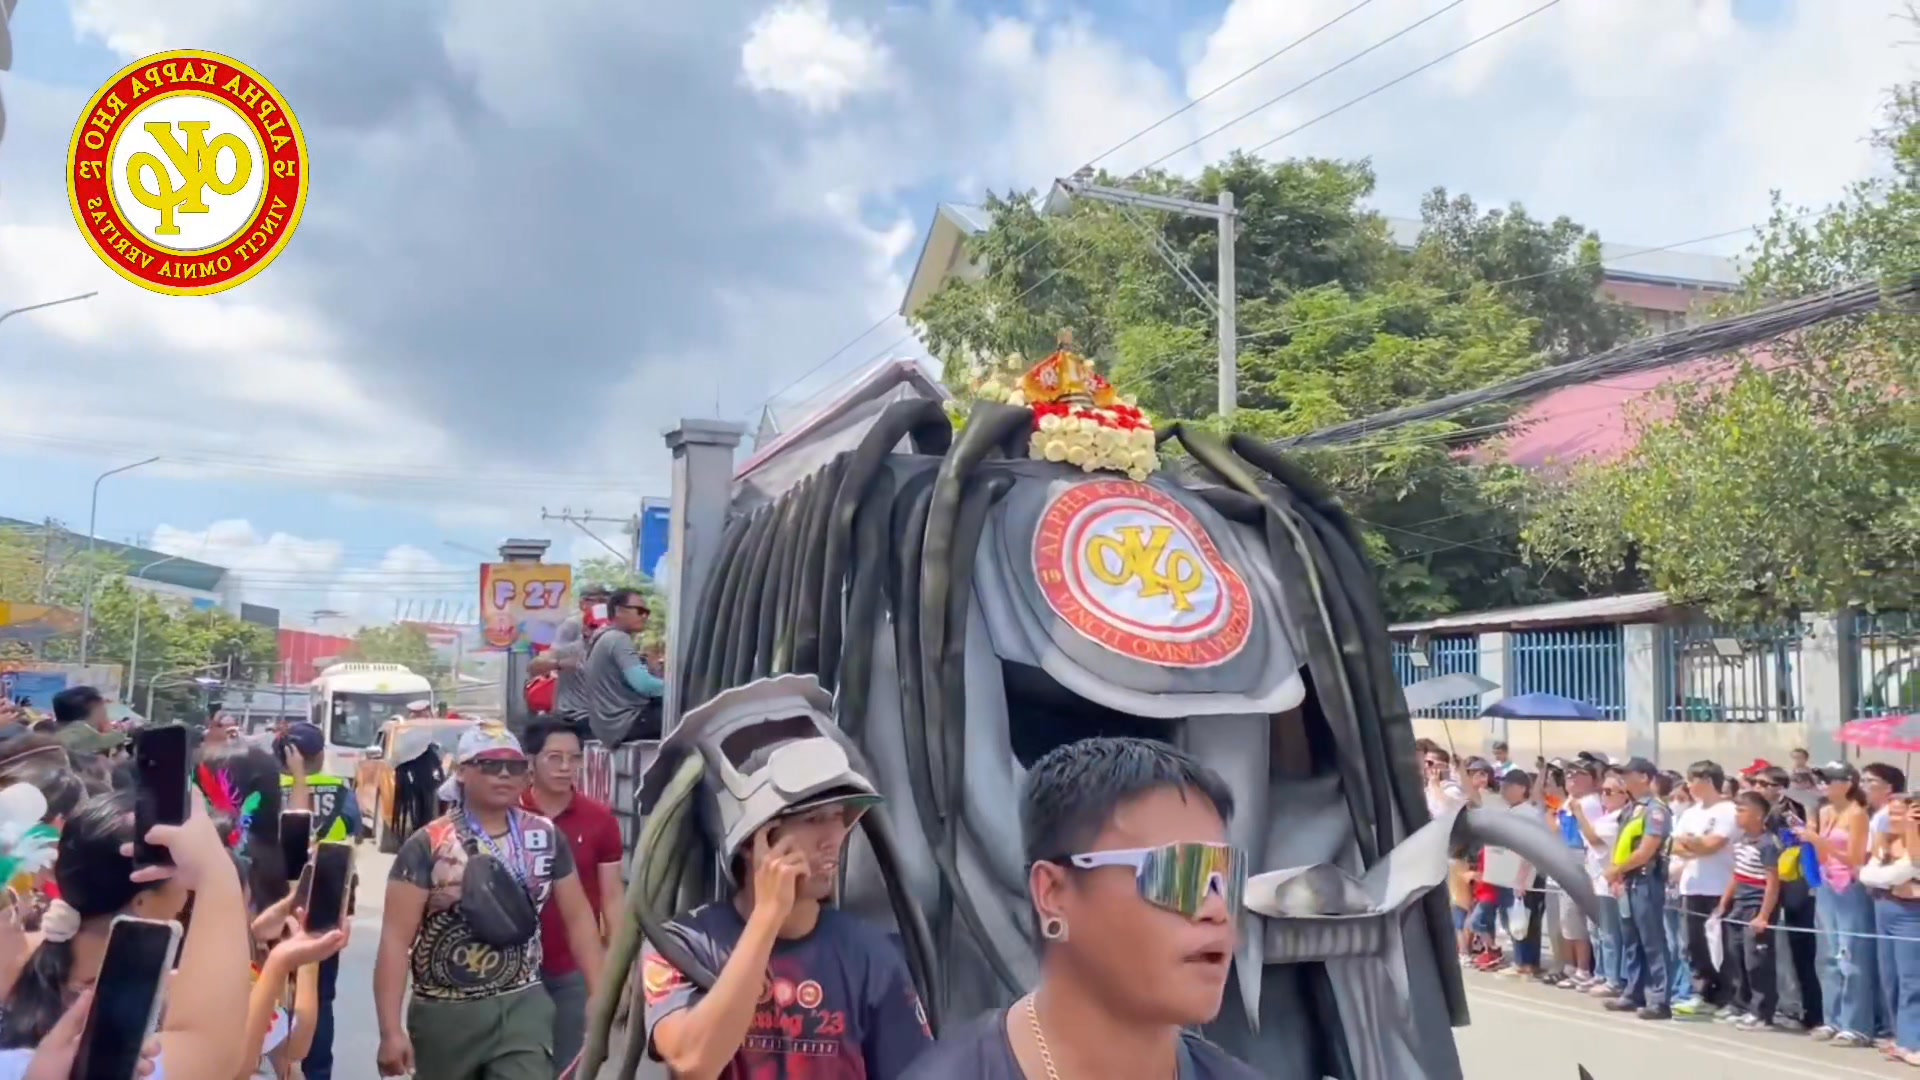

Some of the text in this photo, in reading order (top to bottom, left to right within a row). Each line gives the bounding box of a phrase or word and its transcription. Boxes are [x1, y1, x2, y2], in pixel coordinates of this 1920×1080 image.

[1040, 488, 1089, 559] ALPHA
[492, 579, 567, 609] F 27
[1133, 639, 1208, 661] OMNIA
